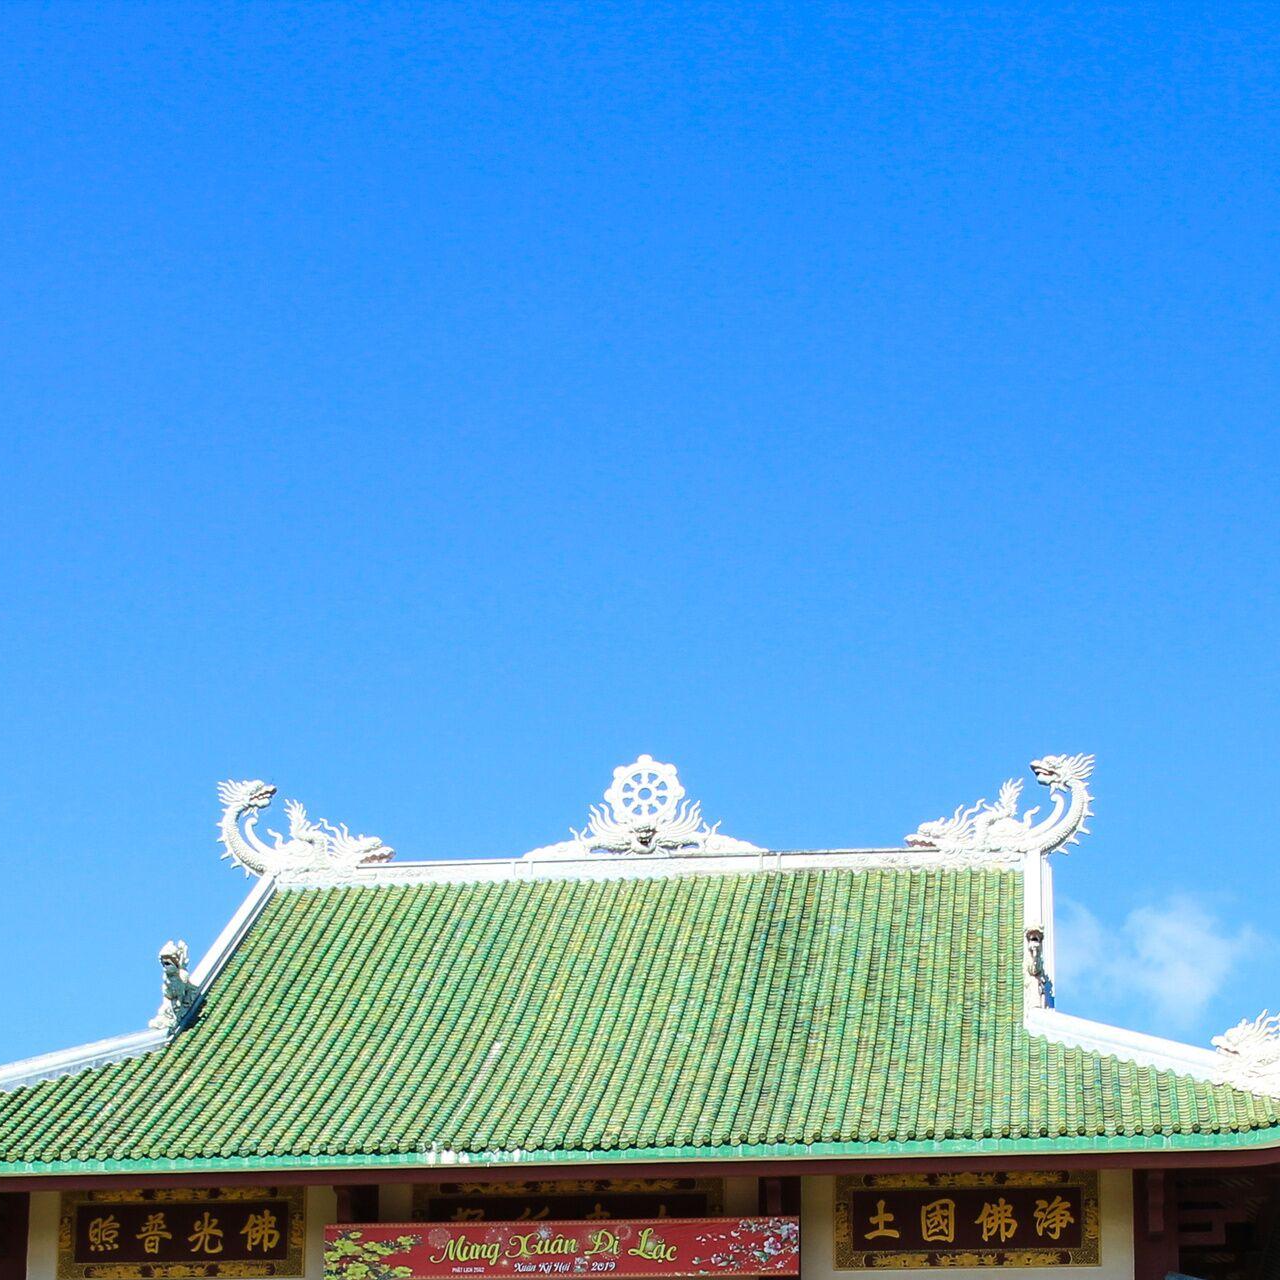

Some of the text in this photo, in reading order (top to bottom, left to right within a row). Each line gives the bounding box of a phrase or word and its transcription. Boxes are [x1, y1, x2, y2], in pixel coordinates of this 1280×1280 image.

[429, 1235, 504, 1266] Mừng
[505, 1232, 578, 1258] Xuân
[627, 1227, 678, 1263] Lặc
[590, 1260, 616, 1272] 2019
